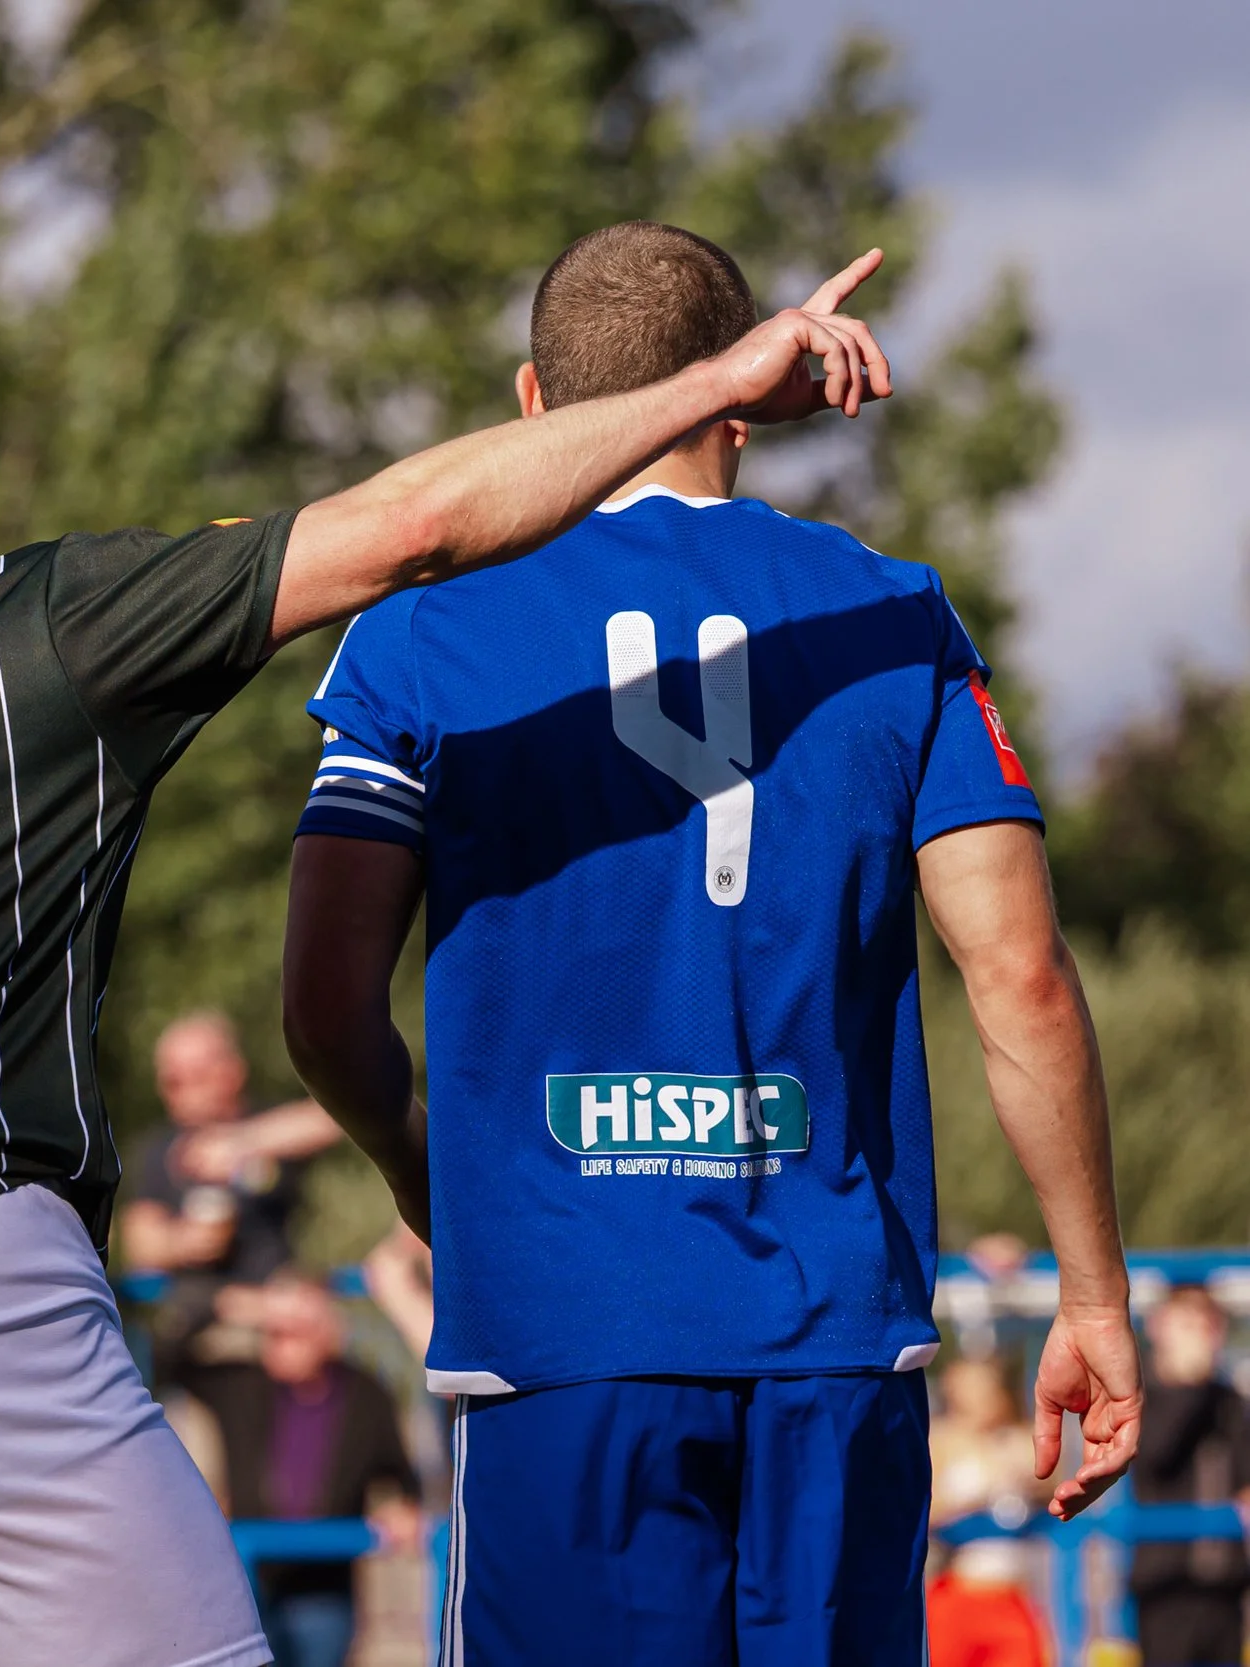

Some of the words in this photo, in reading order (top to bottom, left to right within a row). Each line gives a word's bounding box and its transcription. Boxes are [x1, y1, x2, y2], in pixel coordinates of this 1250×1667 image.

[606, 610, 754, 907] 4
[581, 1159, 612, 1176] LIFE
[616, 1158, 669, 1176] SAFETY
[672, 1159, 682, 1176] &
[684, 1159, 736, 1178] HOUSING
[740, 1157, 782, 1178] SOLONS
